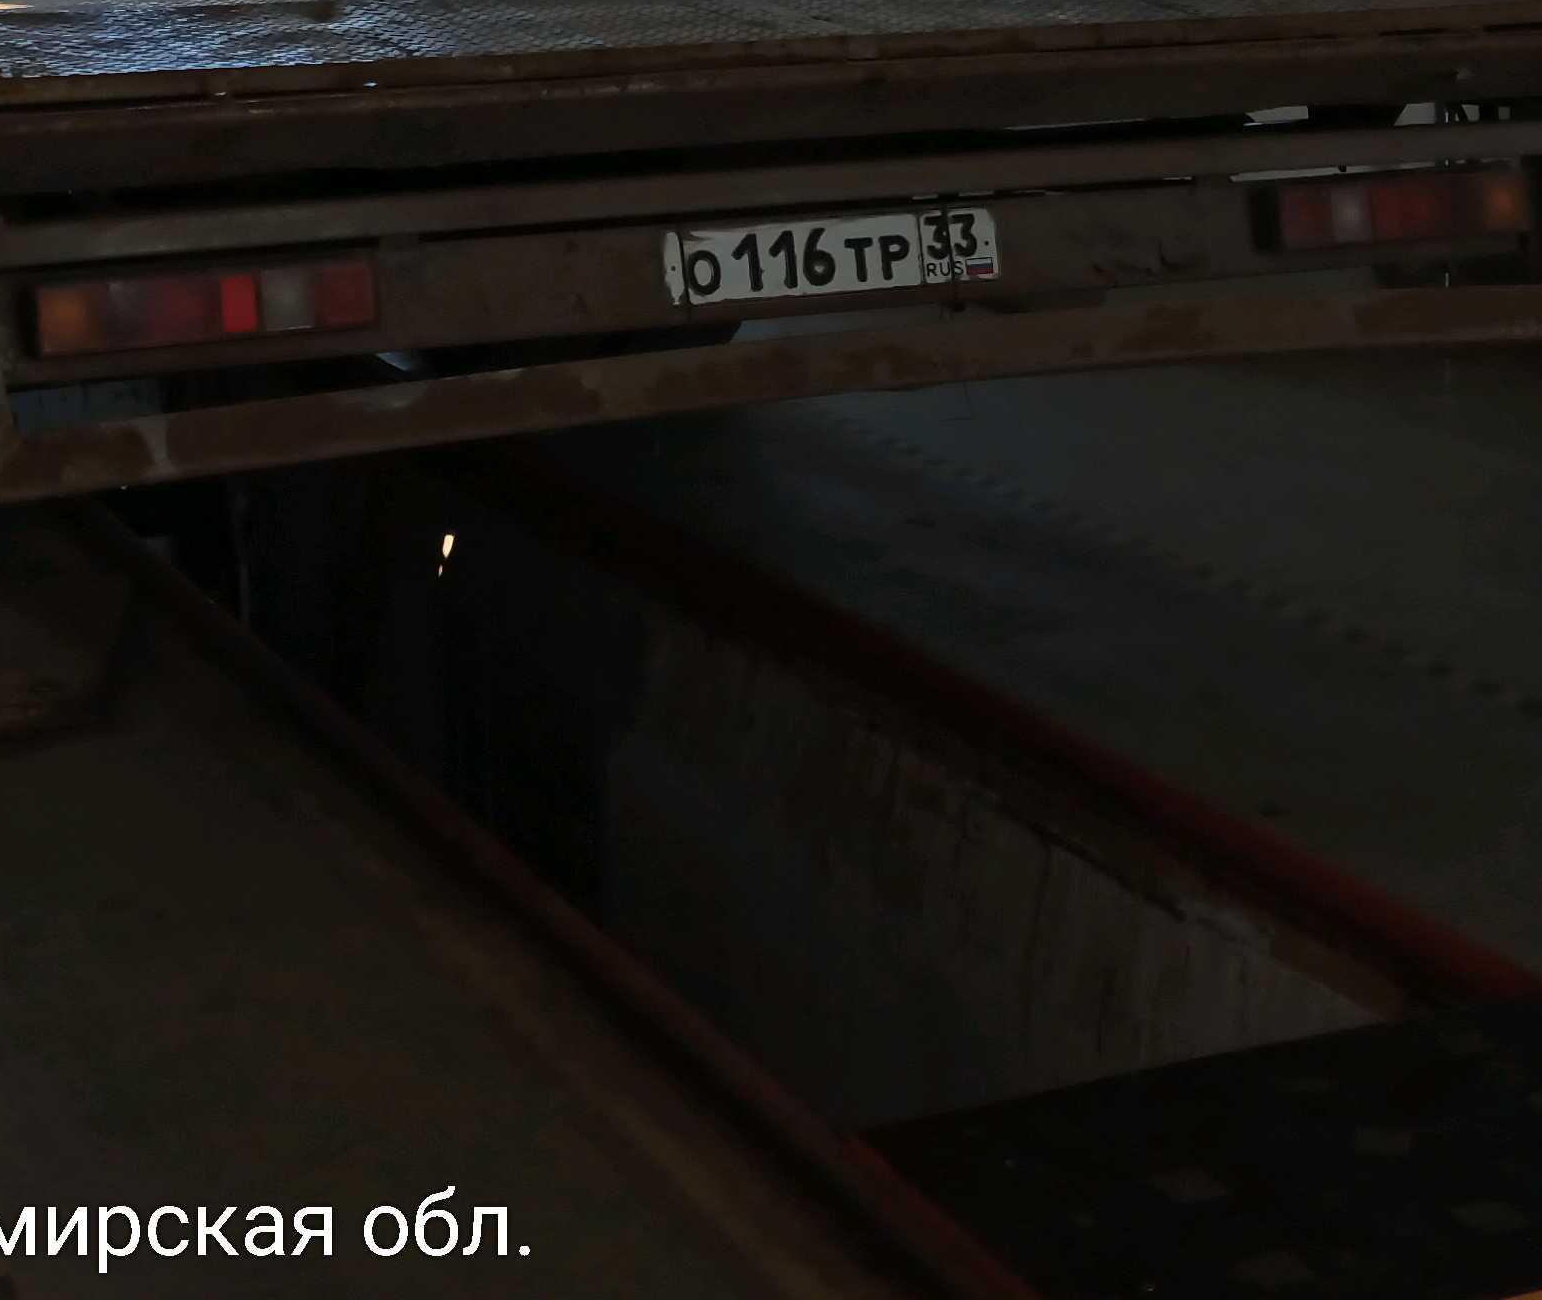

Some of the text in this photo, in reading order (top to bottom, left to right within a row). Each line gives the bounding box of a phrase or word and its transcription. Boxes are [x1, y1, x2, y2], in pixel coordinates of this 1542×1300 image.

[687, 213, 977, 296] О116ТР 33
[926, 260, 963, 278] RUS
